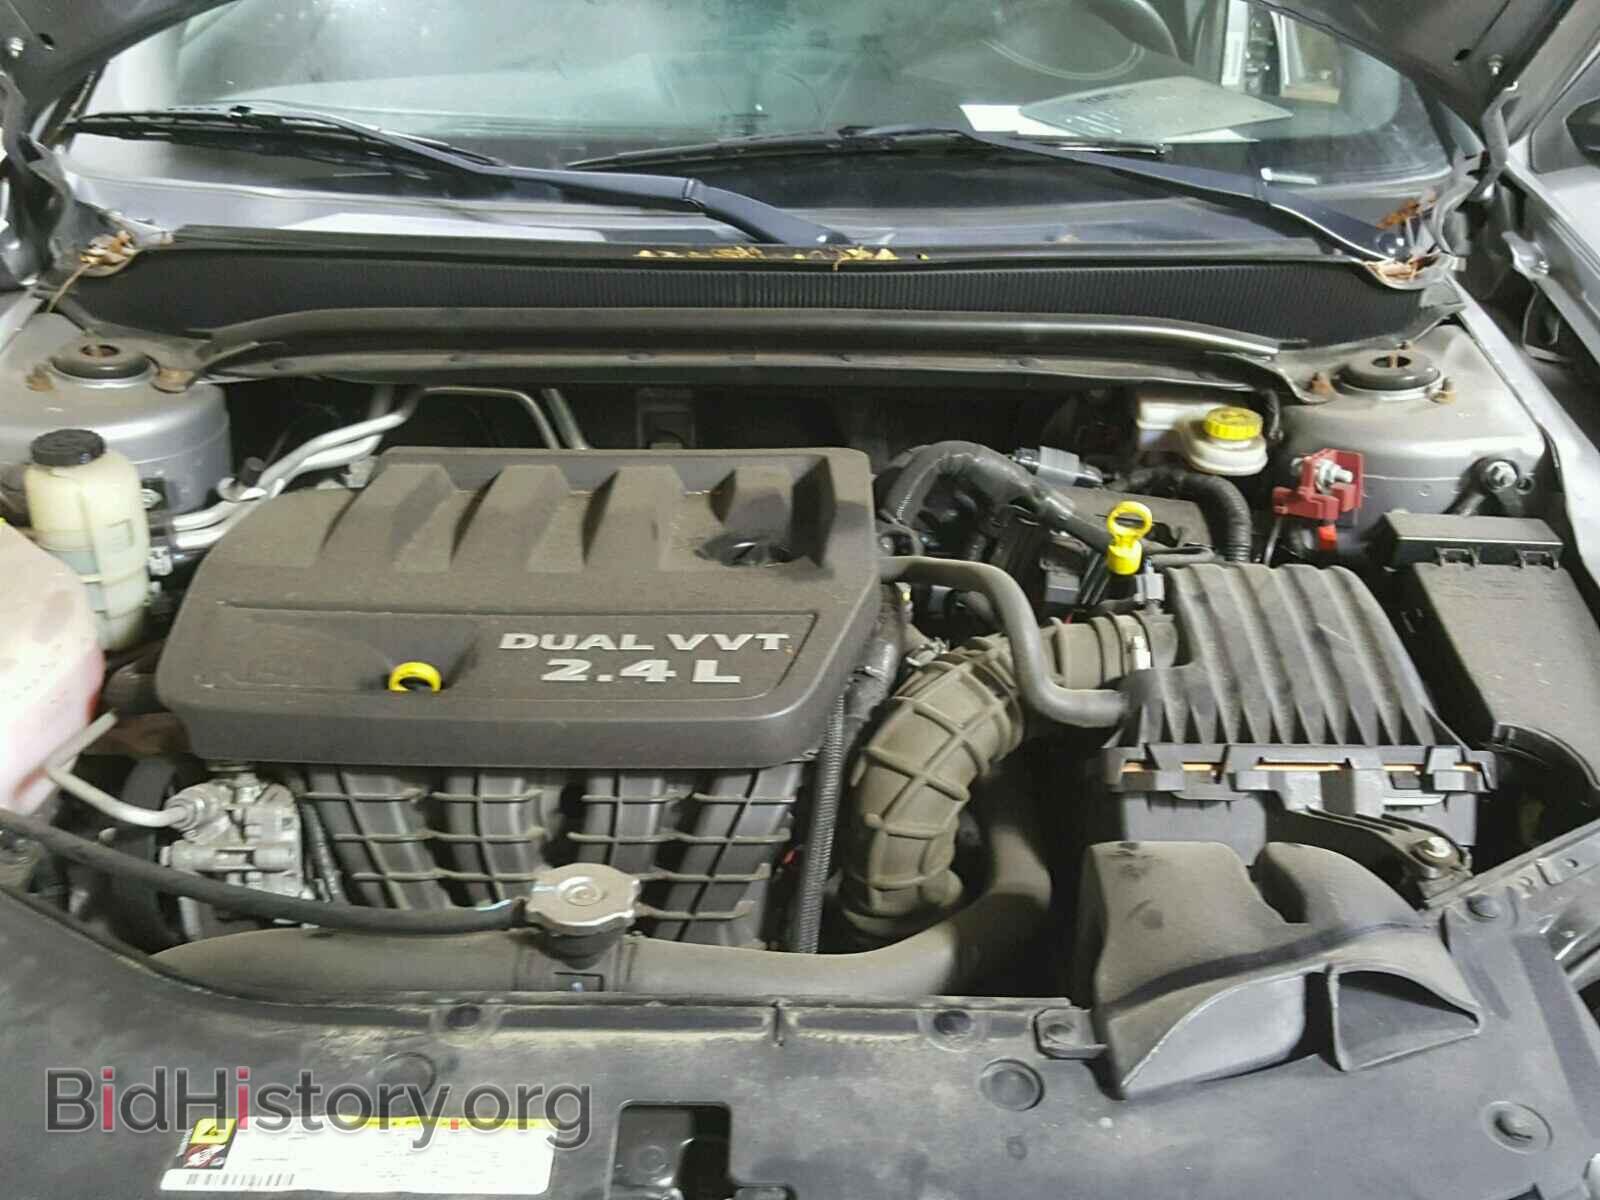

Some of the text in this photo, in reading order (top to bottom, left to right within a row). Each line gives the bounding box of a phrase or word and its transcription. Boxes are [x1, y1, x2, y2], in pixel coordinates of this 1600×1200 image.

[499, 633, 790, 651] DUAL VVT
[540, 658, 742, 684] 2.4 L
